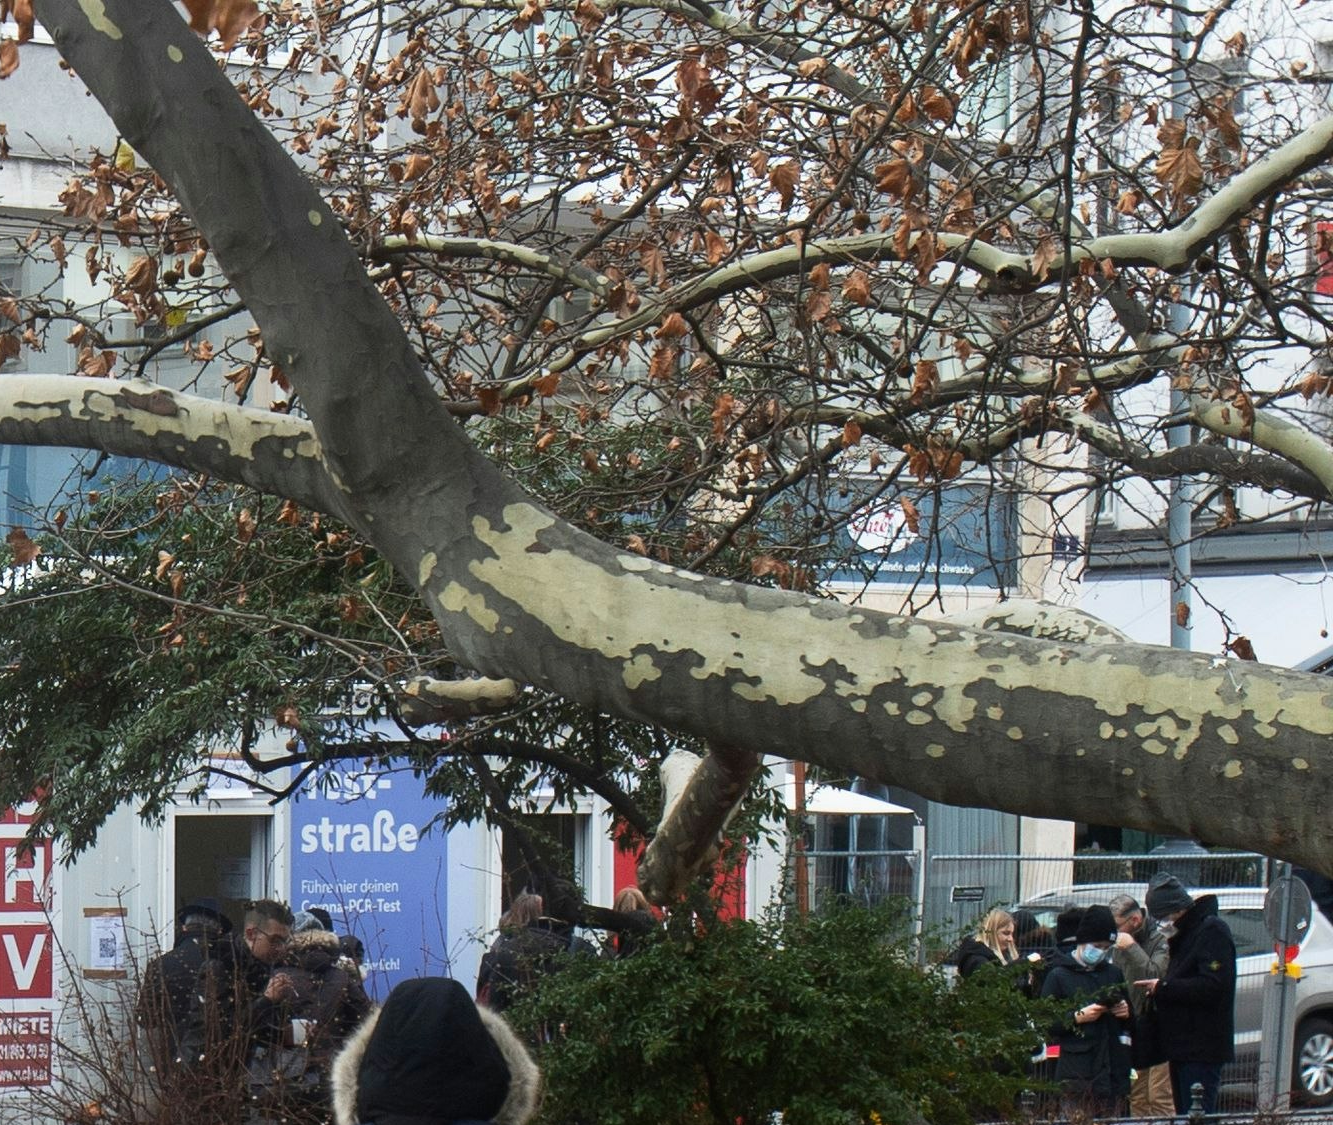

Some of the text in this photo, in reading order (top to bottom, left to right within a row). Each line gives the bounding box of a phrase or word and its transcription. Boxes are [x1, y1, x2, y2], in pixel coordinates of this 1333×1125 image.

[300, 809, 419, 853] straße
[301, 880, 334, 894] Führe
[362, 880, 399, 894] deinen
